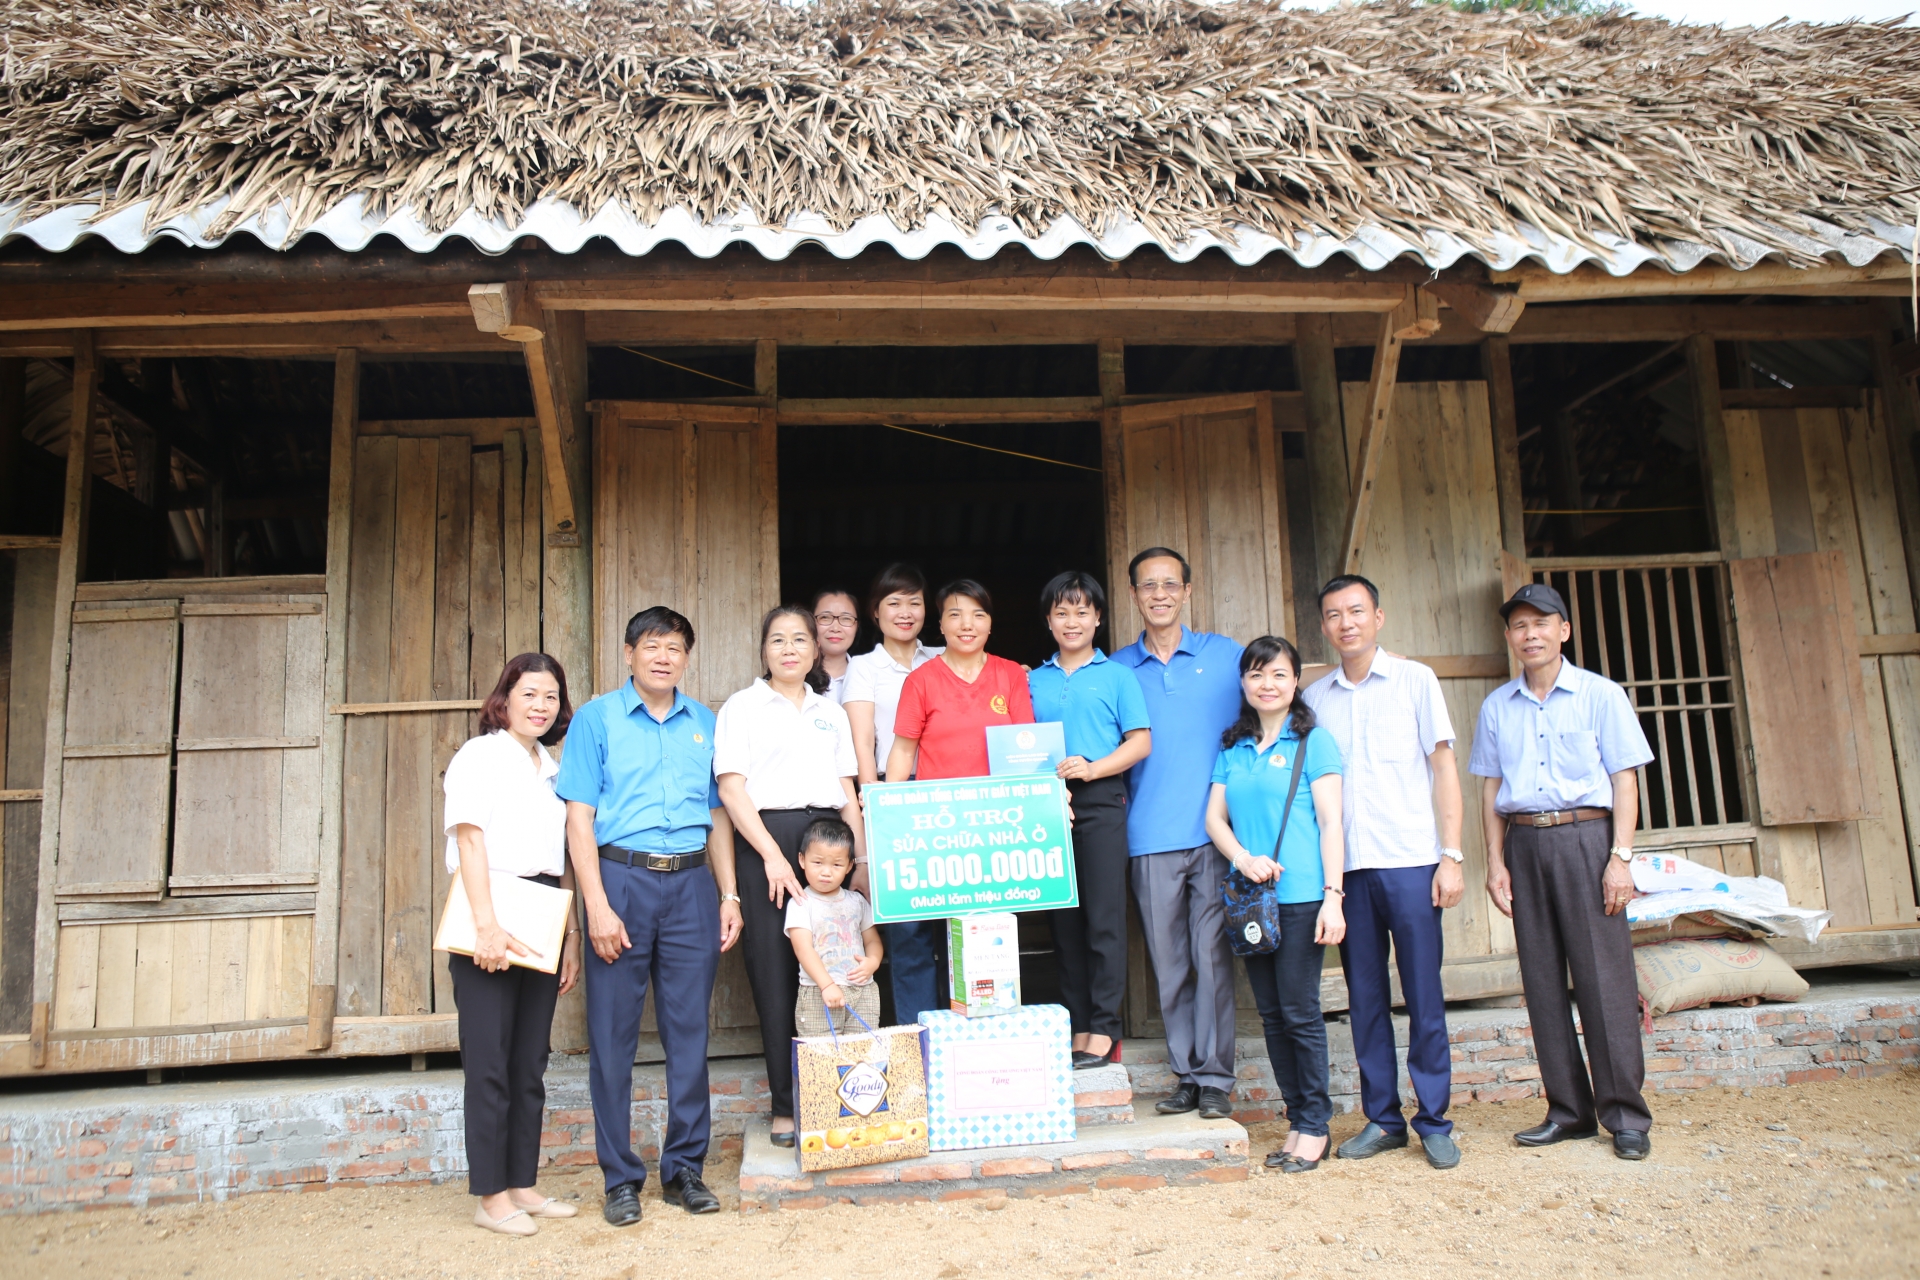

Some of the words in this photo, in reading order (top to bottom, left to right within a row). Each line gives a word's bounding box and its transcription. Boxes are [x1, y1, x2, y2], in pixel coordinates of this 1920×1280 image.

[879, 791, 903, 806] CÔNG
[904, 789, 928, 804] ĐOÀN
[954, 786, 978, 801] CÔNG
[979, 787, 990, 799] TY
[1012, 783, 1029, 798] VIỆT
[1031, 783, 1052, 796] NAM
[911, 805, 956, 830] HỖ
[963, 805, 1024, 827] TRỢ
[892, 833, 928, 853] SỬA
[932, 830, 984, 850] CHỮA
[988, 827, 1028, 846] NHÀ
[1031, 824, 1048, 842] Ở
[881, 846, 1064, 891] 15.000.000đ
[911, 894, 945, 909] (Mười
[948, 892, 972, 905] lăm
[974, 889, 1001, 905] triệu
[1004, 886, 1041, 902] đồng)
[842, 1074, 885, 1102] Goody
